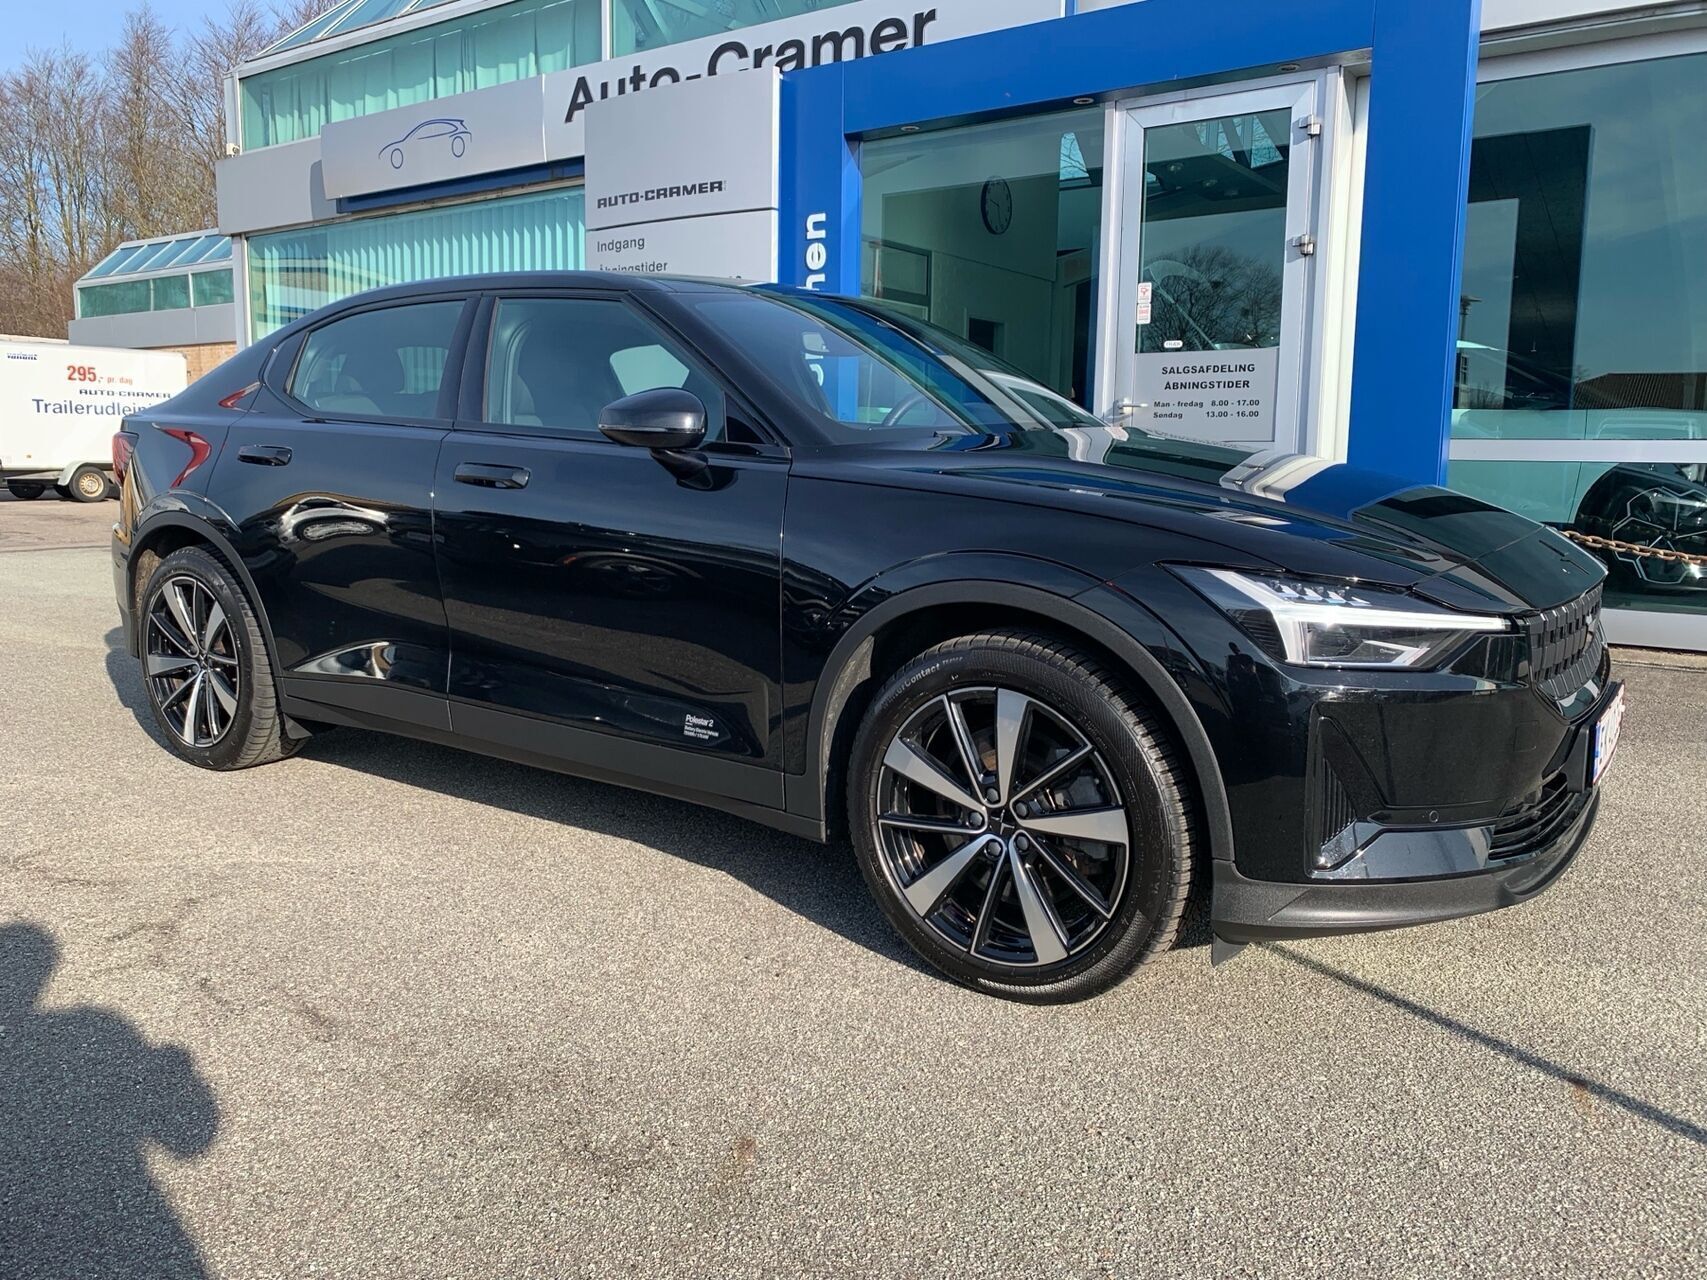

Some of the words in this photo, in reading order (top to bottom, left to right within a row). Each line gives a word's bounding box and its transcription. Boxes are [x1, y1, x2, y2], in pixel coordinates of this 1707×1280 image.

[597, 180, 723, 209] AUTO-CRAMER
[597, 238, 645, 253] Indgang
[1161, 363, 1256, 375] SALGSAFDELING
[1164, 380, 1250, 390] ÅBNINGSTIDER
[1177, 401, 1204, 409] fredag
[1211, 399, 1229, 407] 8.00
[1237, 399, 1260, 407] 17.00
[1206, 410, 1229, 418] 13.00
[1236, 410, 1259, 418] 16.00
[685, 714, 709, 727] Polestar
[708, 719, 714, 728] 2
